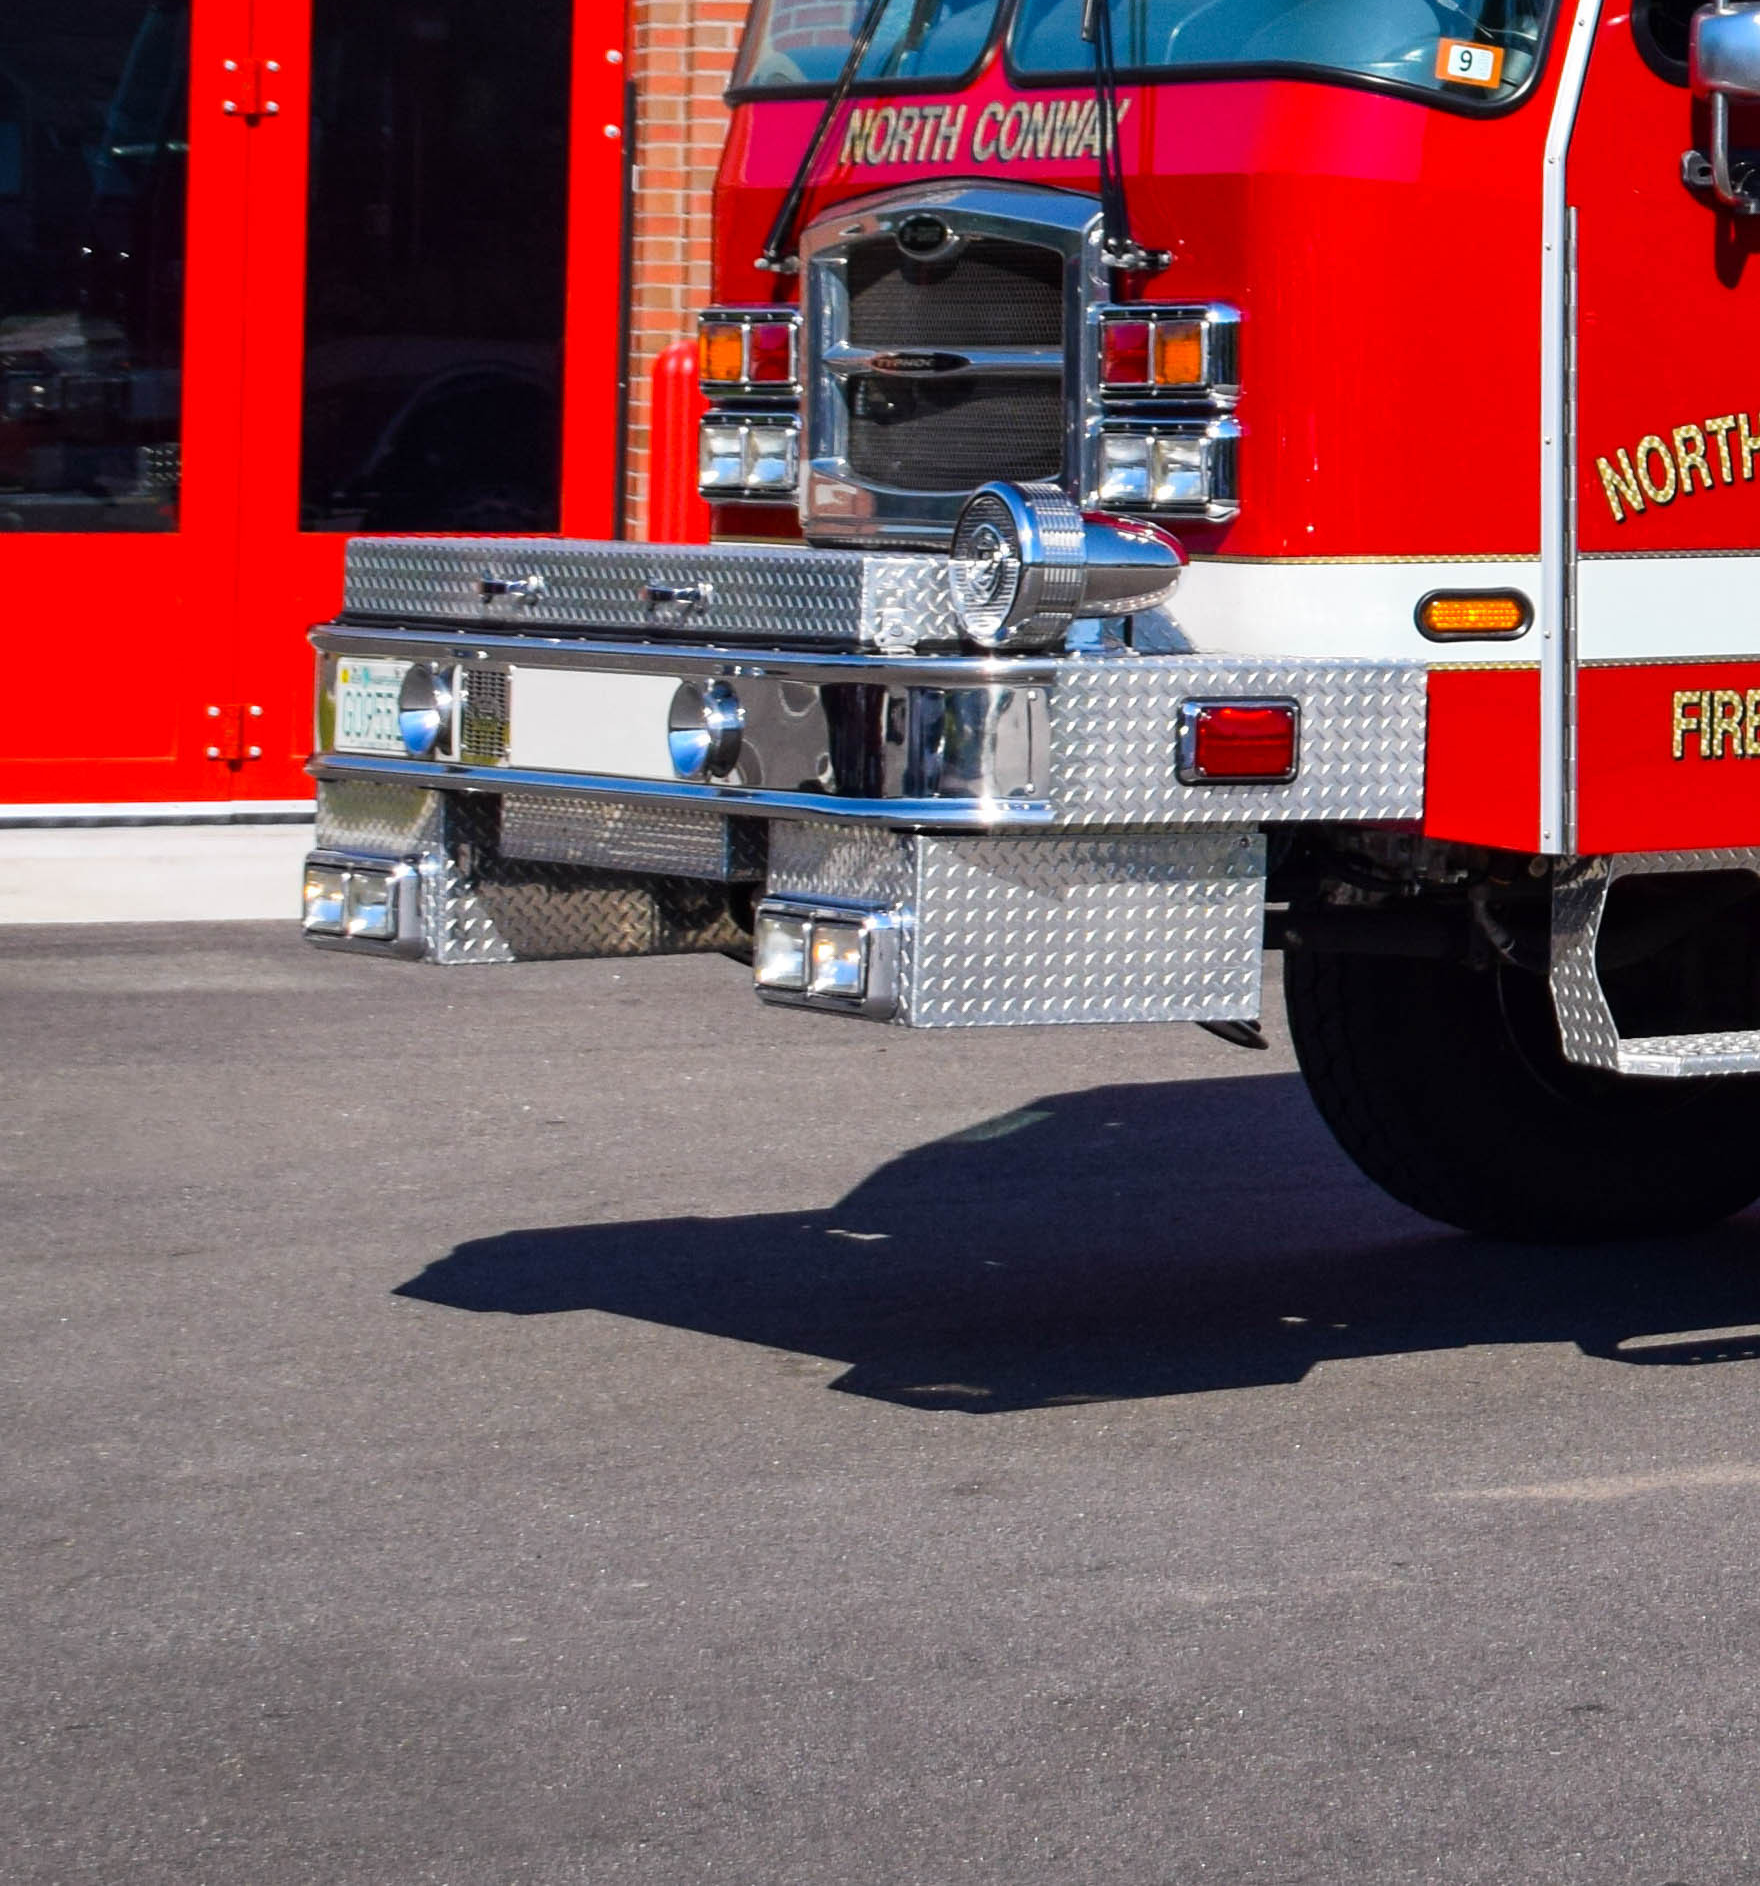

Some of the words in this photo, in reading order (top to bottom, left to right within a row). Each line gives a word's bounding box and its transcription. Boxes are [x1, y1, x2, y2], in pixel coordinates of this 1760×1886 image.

[1459, 50, 1473, 72] 9
[840, 103, 965, 165] NORTH
[971, 98, 1131, 162] CONWAY
